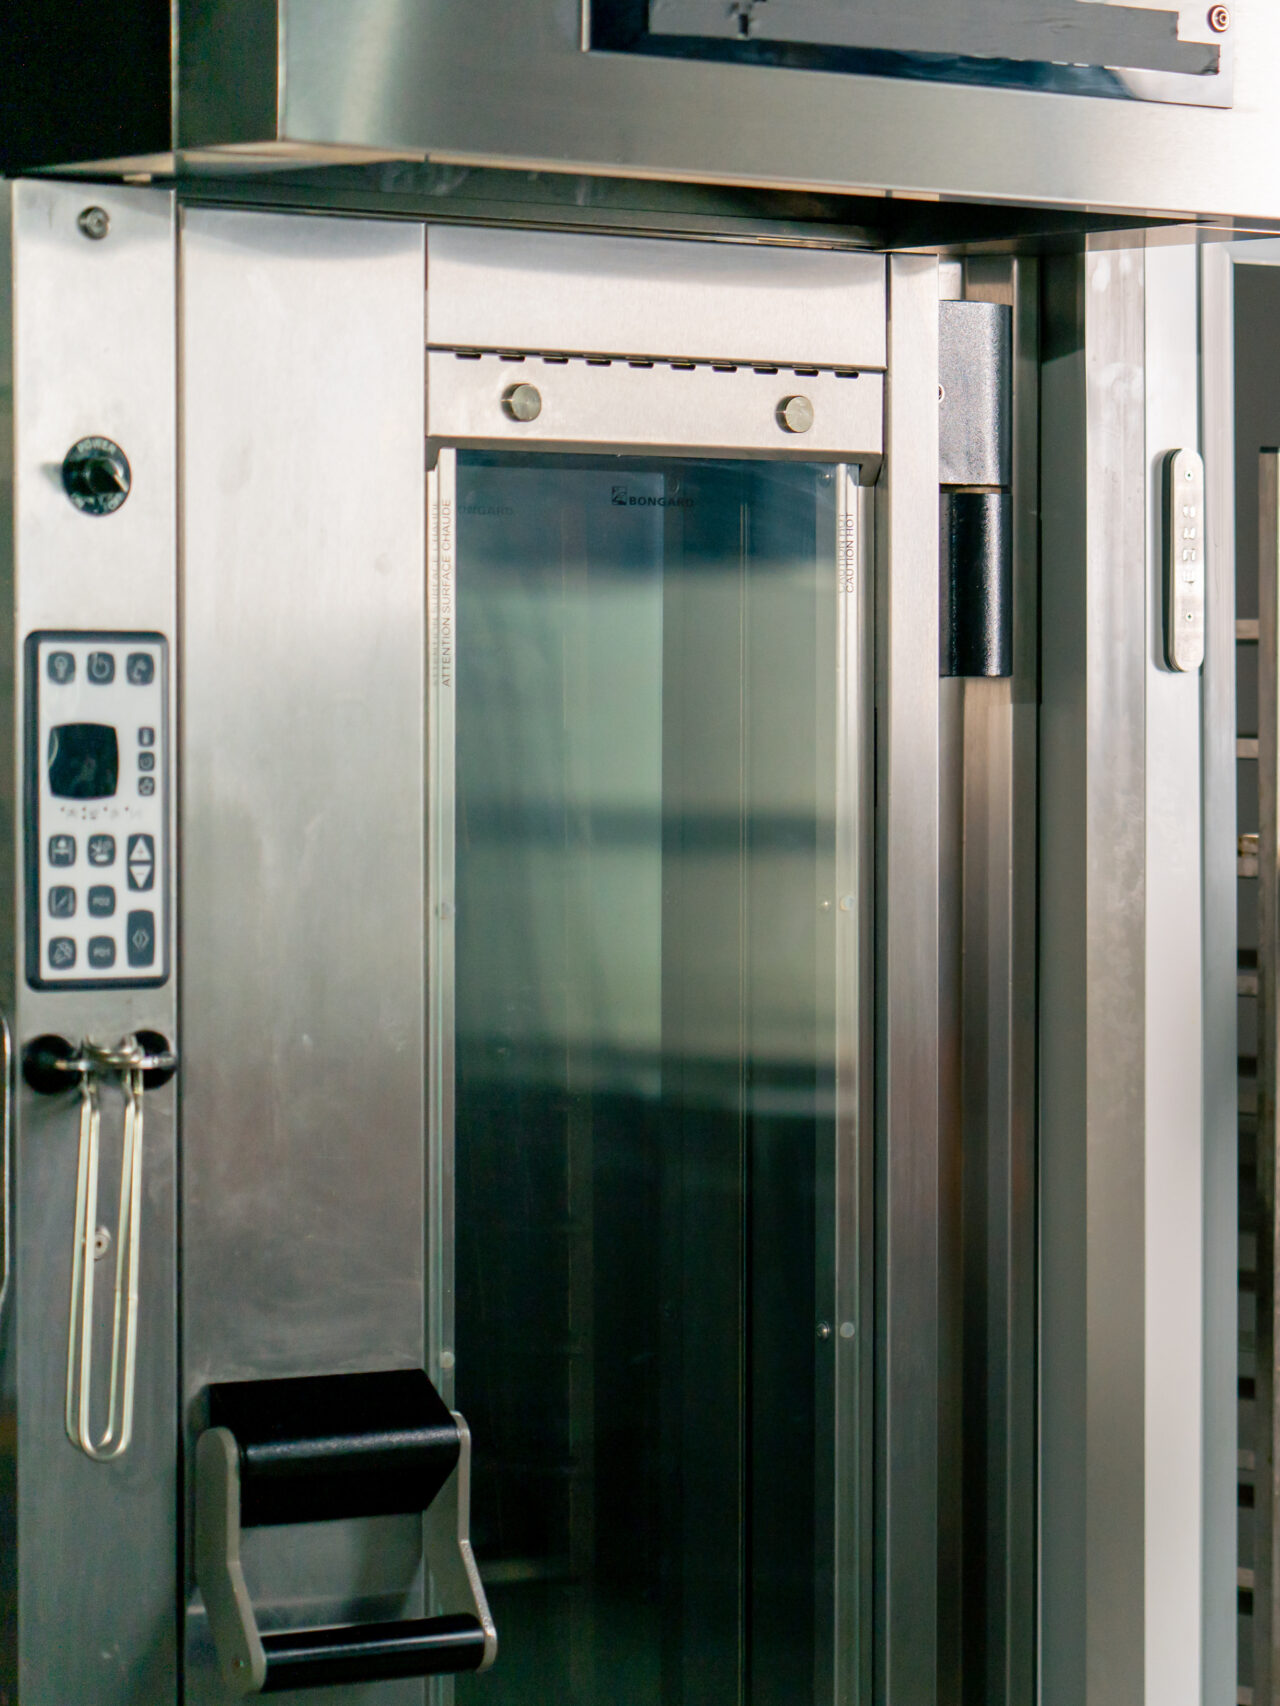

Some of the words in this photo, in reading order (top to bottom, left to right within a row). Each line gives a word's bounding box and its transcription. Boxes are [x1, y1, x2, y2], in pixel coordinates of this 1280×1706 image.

[77, 438, 117, 455] POWER
[441, 499, 451, 551] CHAUDE
[629, 496, 694, 507] BONGARD
[845, 513, 854, 537] HOT
[441, 555, 451, 614] SURFACE
[845, 540, 854, 593] CAUTION
[441, 617, 451, 688] ATTENTION
